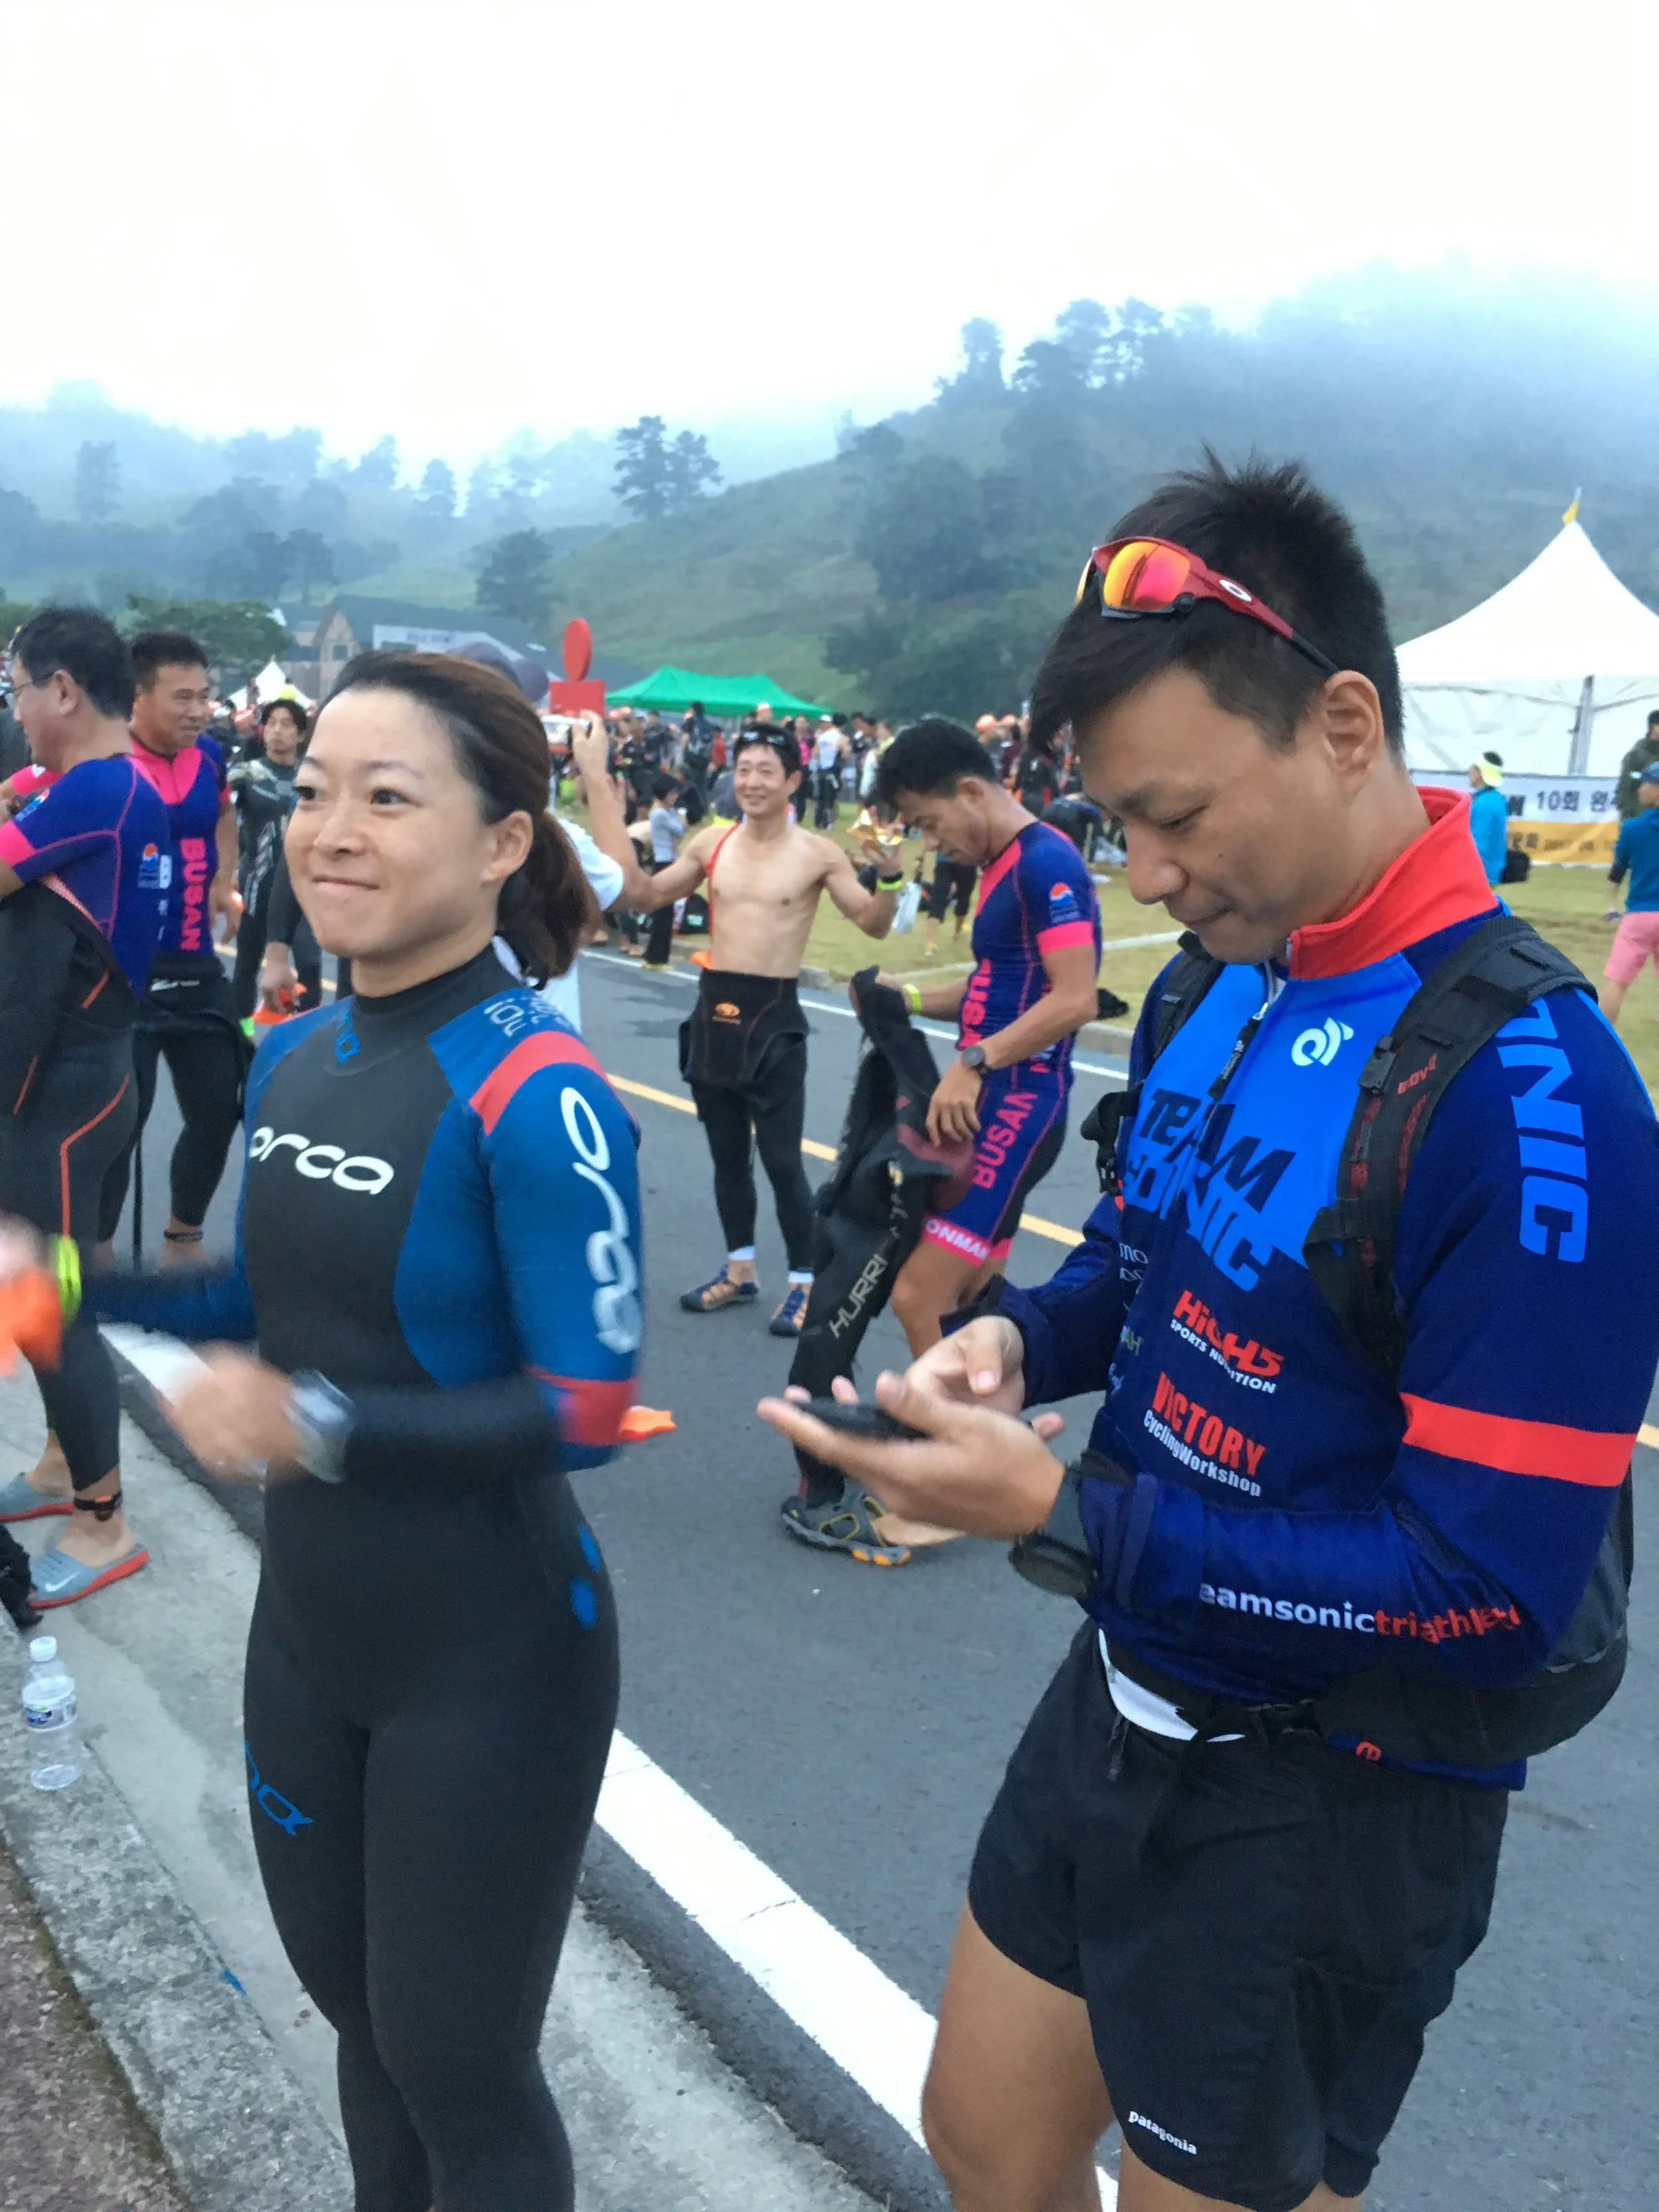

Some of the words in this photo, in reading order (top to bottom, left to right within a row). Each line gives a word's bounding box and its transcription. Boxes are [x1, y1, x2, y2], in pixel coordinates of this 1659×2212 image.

[179, 837, 208, 951] BUSAN
[250, 1126, 395, 1195] orca
[971, 1091, 1038, 1189] BUSAN
[1170, 1318, 1208, 1352] SPORTS
[1209, 1348, 1277, 1394] NUITION
[1153, 1371, 1267, 1464] VICTORY
[1128, 2110, 1197, 2156] patagonia
